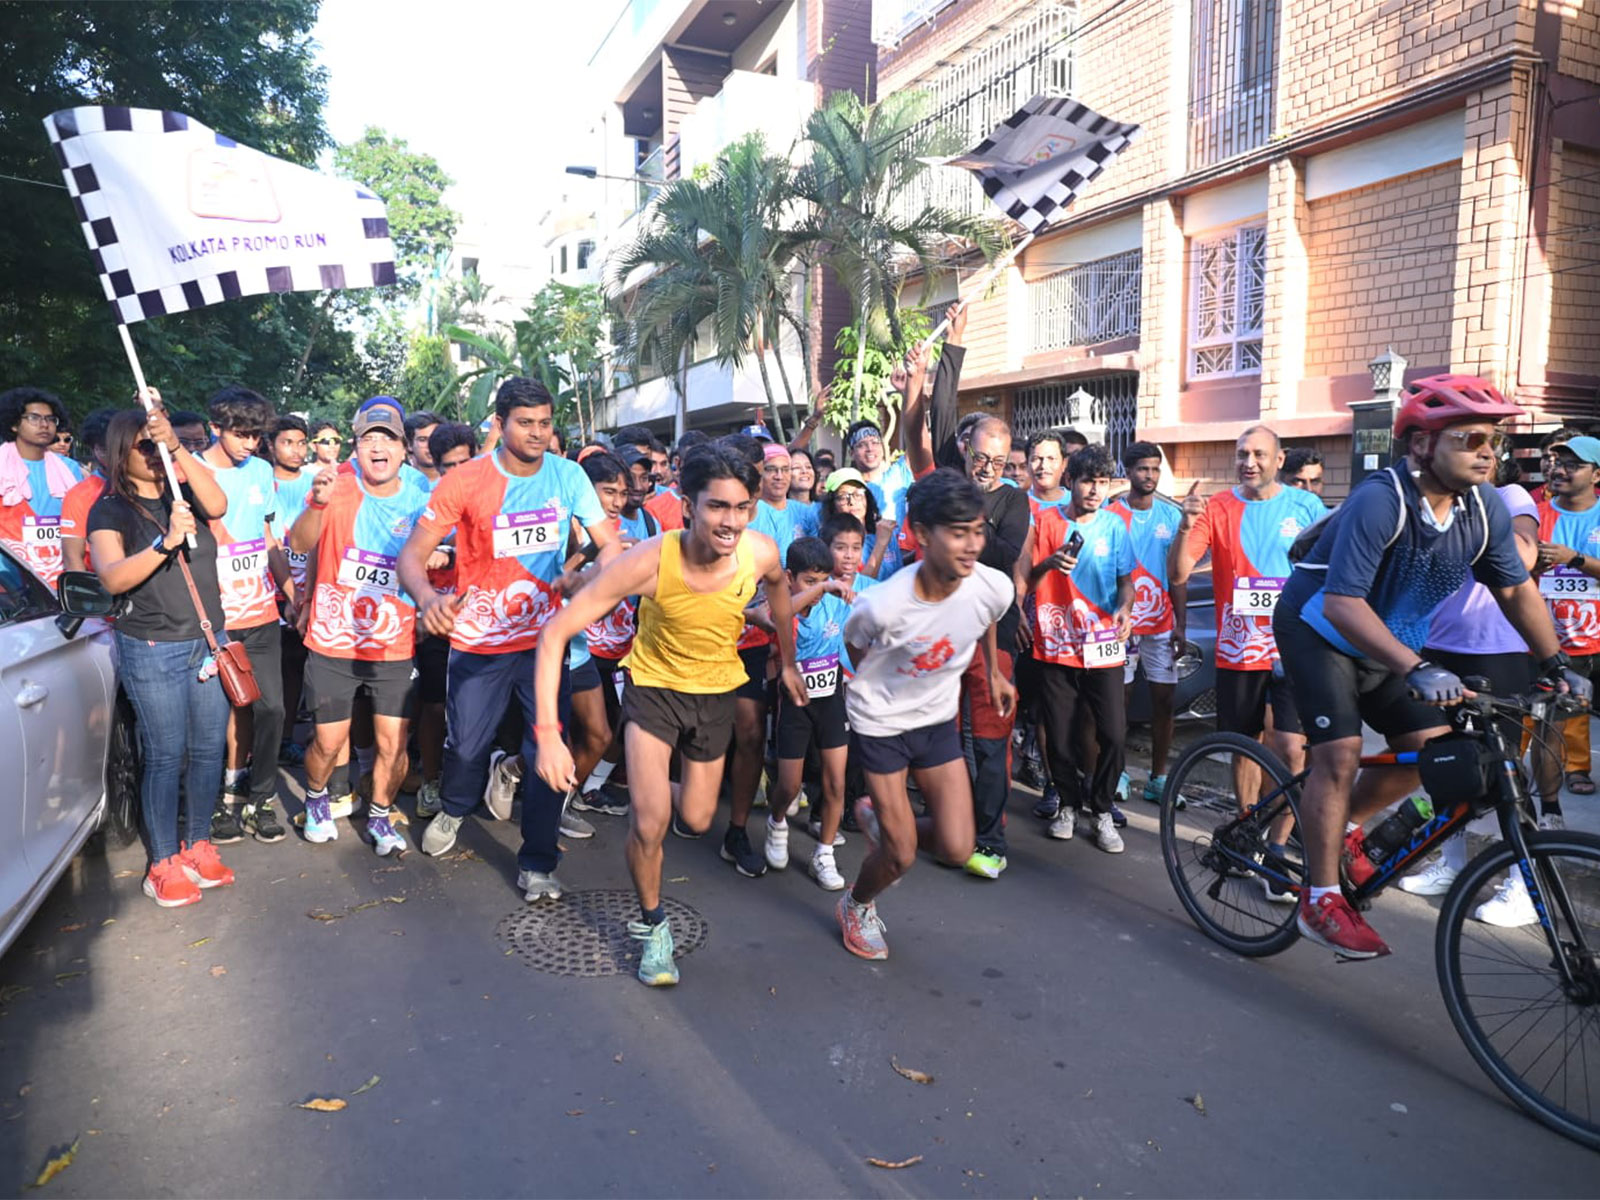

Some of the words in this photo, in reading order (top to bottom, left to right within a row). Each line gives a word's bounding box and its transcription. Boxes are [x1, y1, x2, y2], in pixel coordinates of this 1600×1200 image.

[168, 238, 227, 264] KOLKATA
[232, 235, 289, 252] PROMO
[294, 233, 327, 248] RUN
[511, 526, 547, 546] 178
[232, 553, 258, 572] 007
[355, 565, 390, 586] 043
[1554, 578, 1588, 592] 333
[1096, 641, 1120, 658] 189
[805, 670, 836, 690] 082
